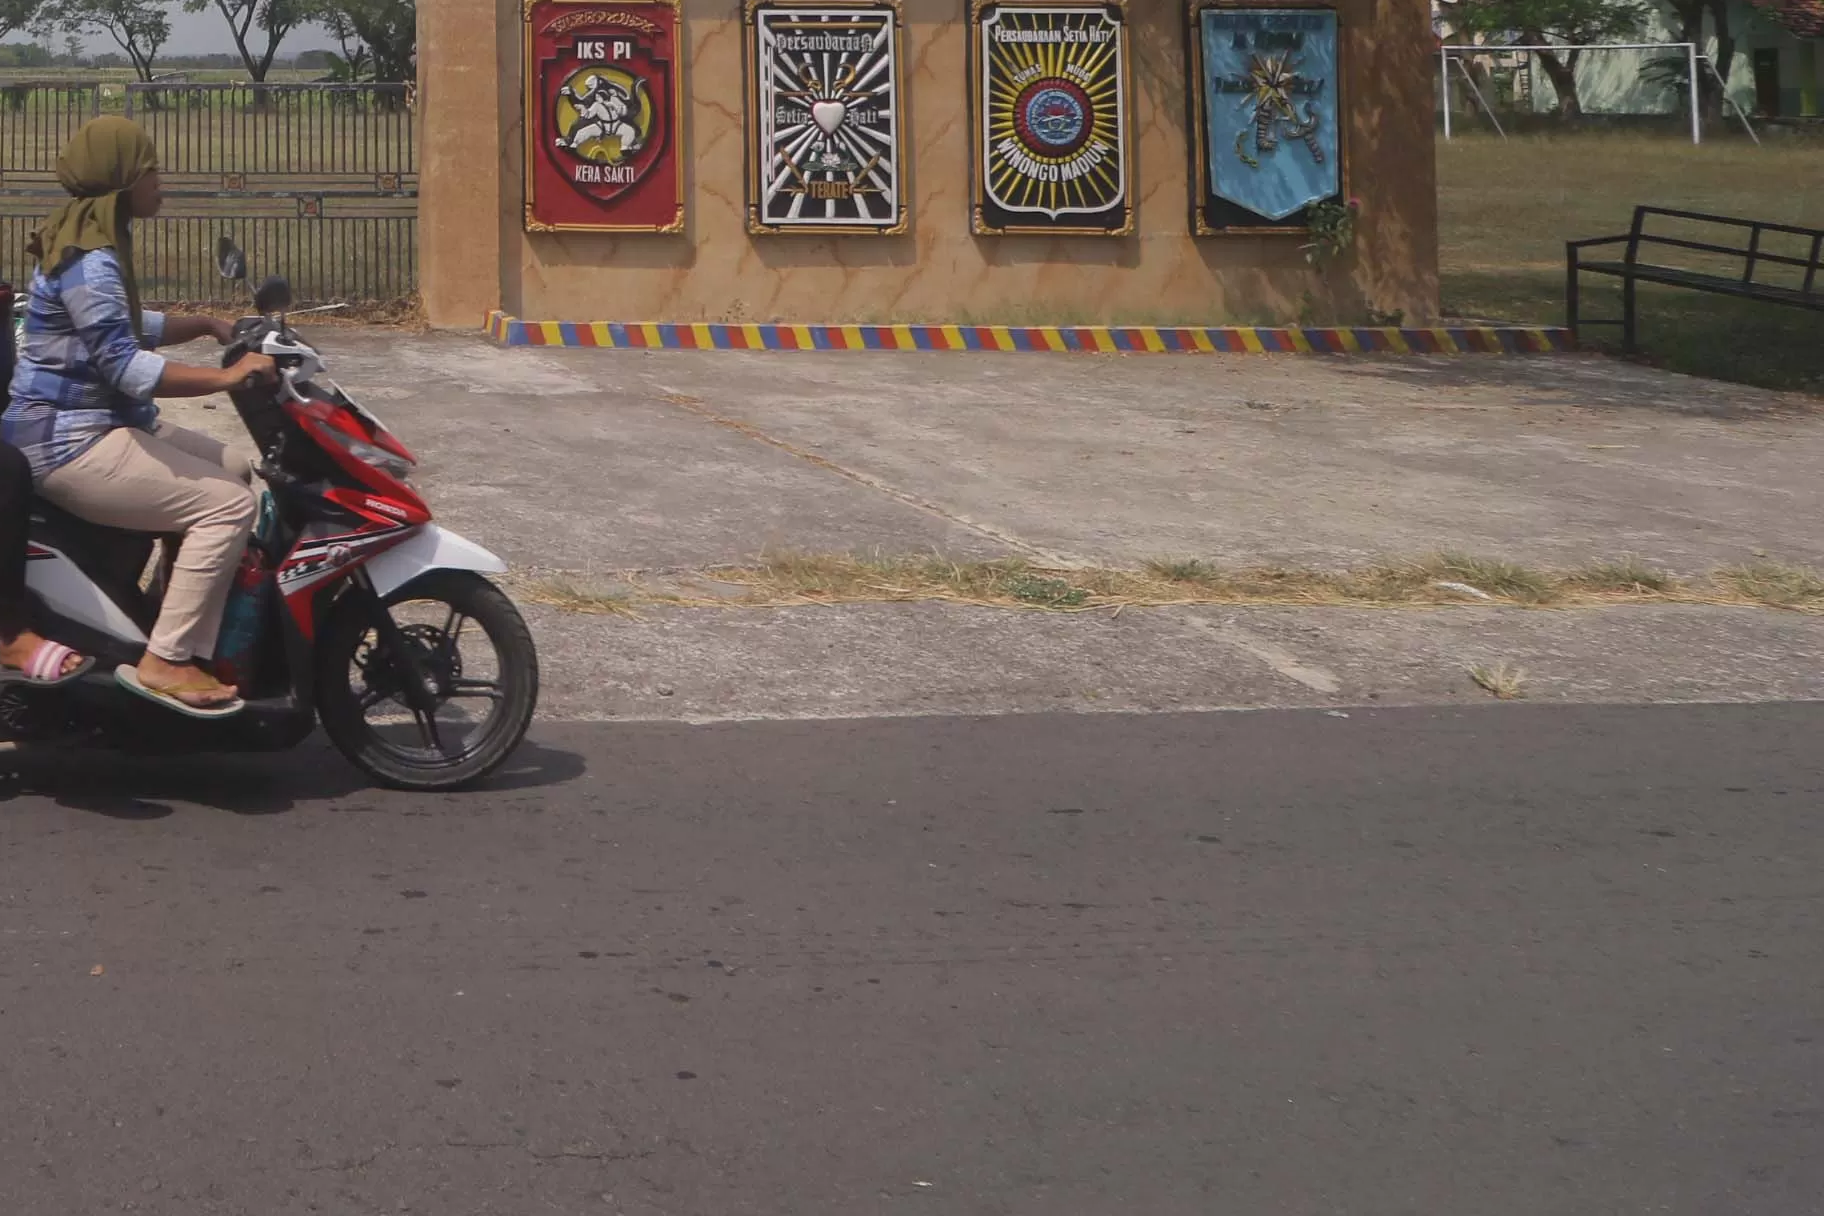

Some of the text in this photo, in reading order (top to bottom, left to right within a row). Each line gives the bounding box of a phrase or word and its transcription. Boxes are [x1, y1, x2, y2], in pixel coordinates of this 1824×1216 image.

[577, 41, 631, 60] IKS PI
[997, 138, 1110, 182] WINONGO MADIUN
[575, 165, 635, 184] KERA SAKTI
[810, 180, 850, 199] TERATE
